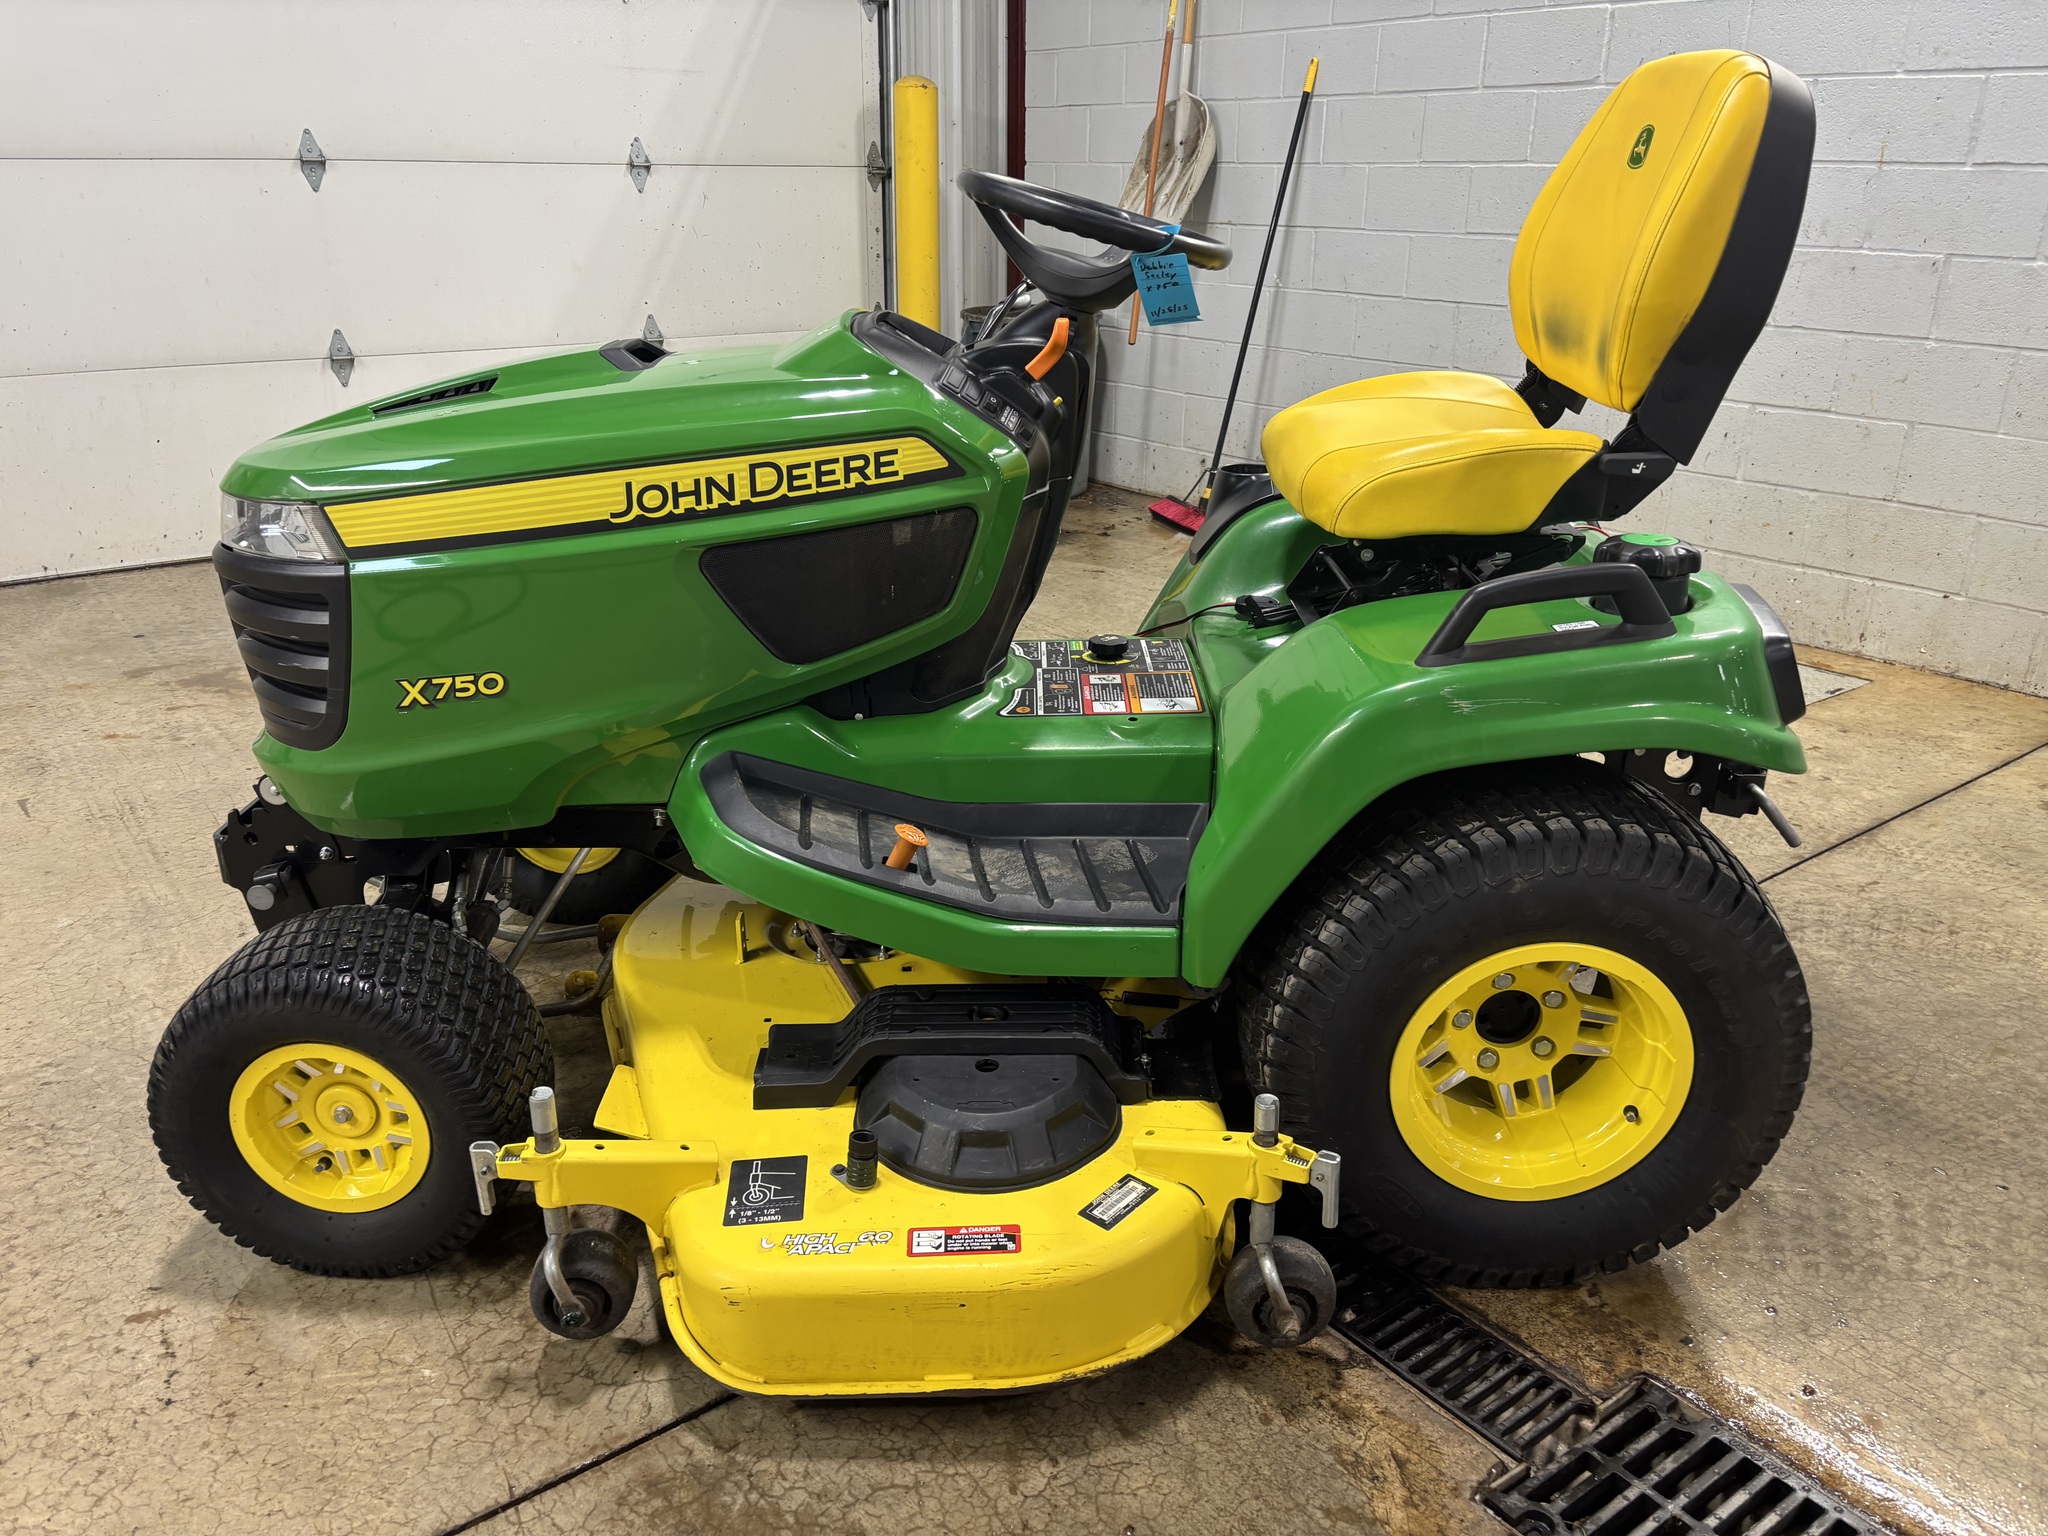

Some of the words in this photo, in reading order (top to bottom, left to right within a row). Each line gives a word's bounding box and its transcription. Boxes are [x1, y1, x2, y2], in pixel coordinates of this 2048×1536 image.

[1140, 261, 1174, 272] Debbie
[609, 472, 738, 521] JOHN
[748, 447, 902, 499] DEERE
[396, 671, 508, 708] X750
[783, 1232, 837, 1246] HIGH
[858, 1230, 893, 1243] 60
